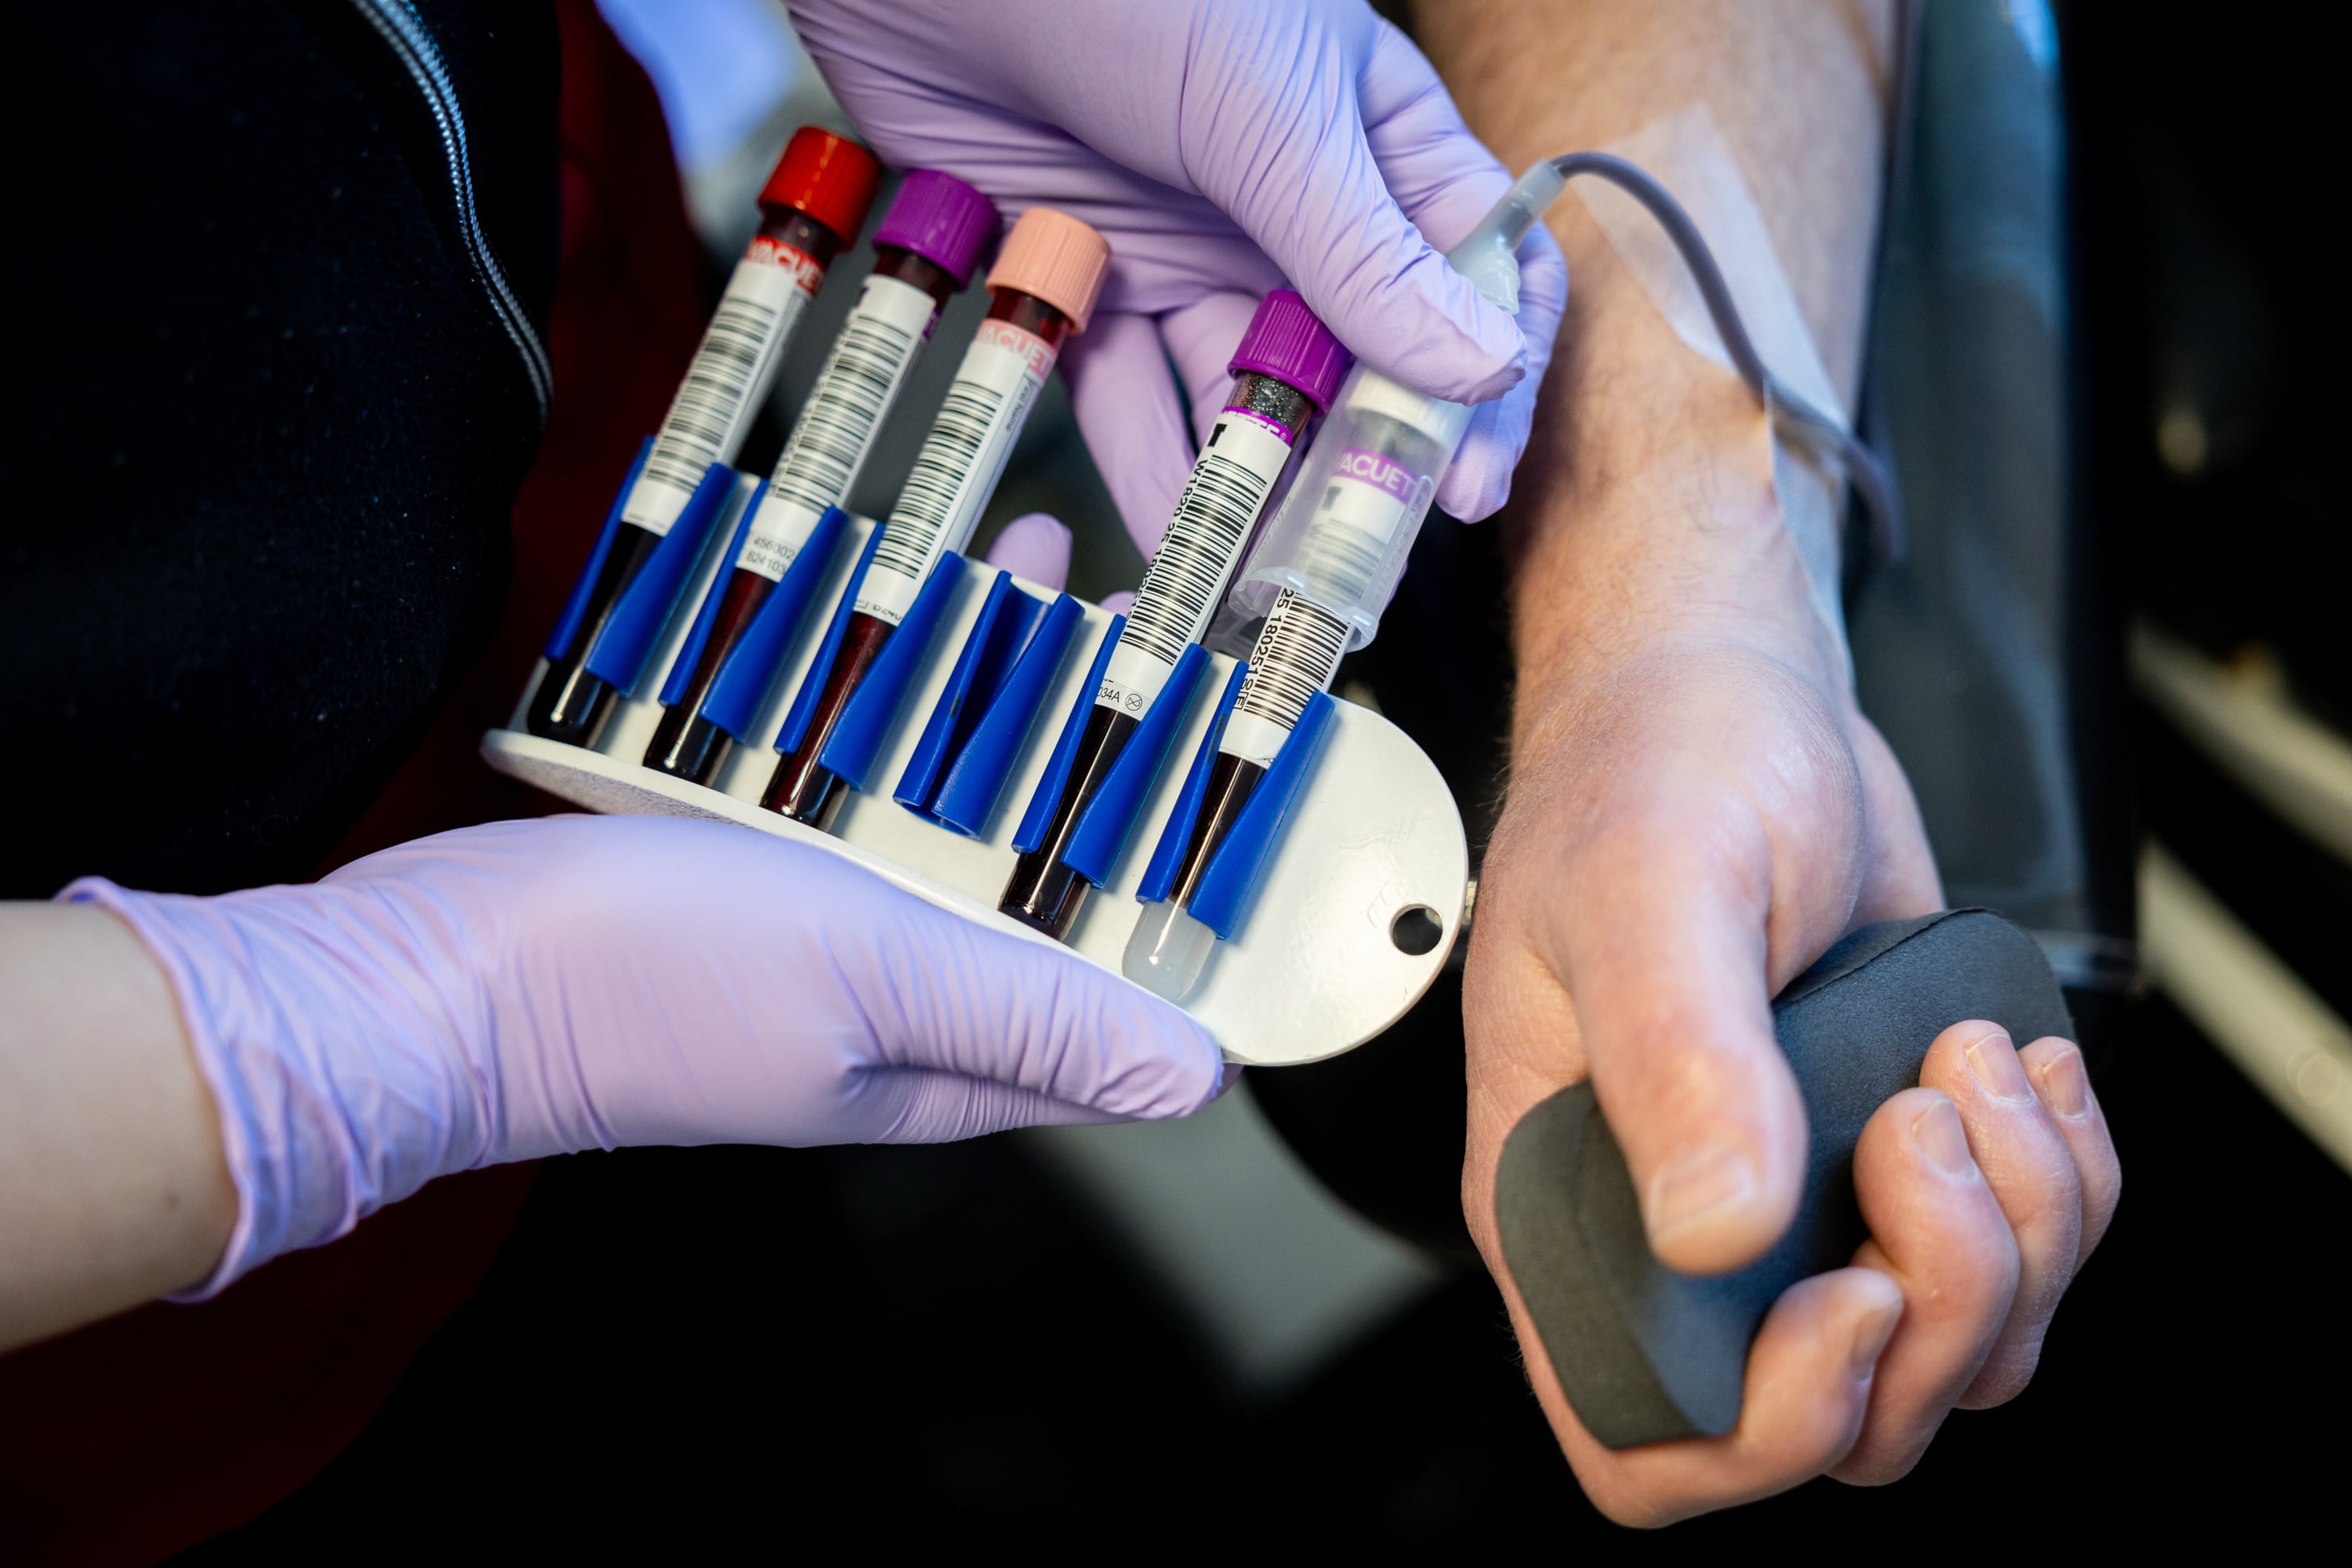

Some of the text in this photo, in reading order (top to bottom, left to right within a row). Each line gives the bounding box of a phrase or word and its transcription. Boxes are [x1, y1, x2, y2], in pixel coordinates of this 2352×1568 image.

[1173, 459, 1208, 517] W1820
[1336, 452, 1414, 496] ACUET
[1276, 588, 1294, 608] 25
